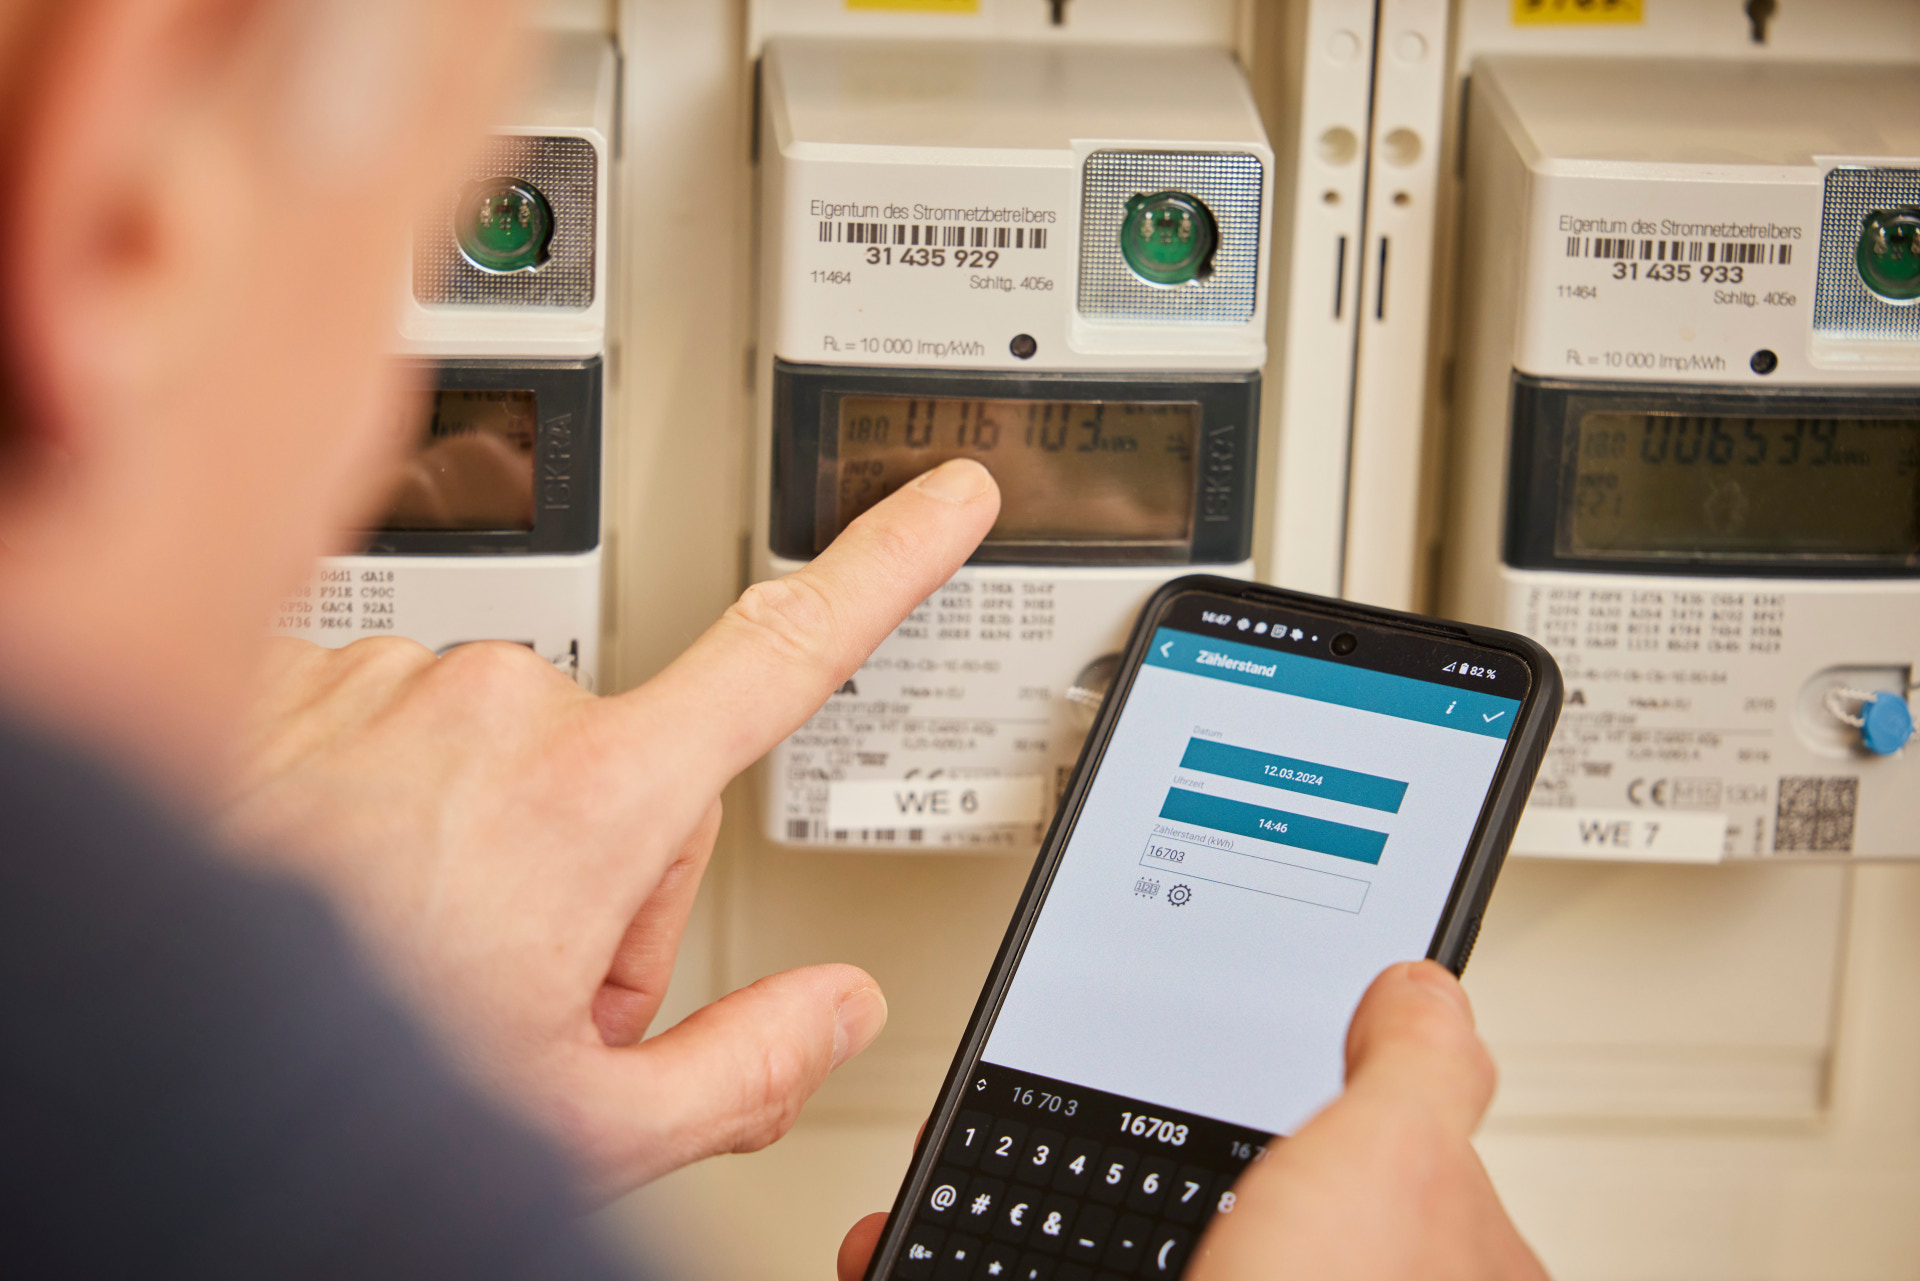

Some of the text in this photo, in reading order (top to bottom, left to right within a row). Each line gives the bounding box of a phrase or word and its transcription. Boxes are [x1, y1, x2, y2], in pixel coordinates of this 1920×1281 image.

[810, 200, 1057, 224] Eigentum des Stromnetzbetreibers
[1559, 215, 1802, 240] Eigentum des Stromnetzbetreibers
[866, 247, 999, 268] 31 435 929
[811, 270, 852, 285] 11464
[1020, 276, 1054, 291] 405e
[1612, 262, 1744, 284] 31 435 933
[1557, 285, 1598, 299] 11464
[860, 337, 880, 353] 10
[883, 338, 913, 354] 000
[1626, 353, 1655, 368] 000
[1196, 649, 1278, 678] Zählerstand
[1470, 666, 1496, 680] 82 %
[1193, 725, 1223, 738] Datum
[1173, 776, 1205, 789] Uhrzeit
[1264, 764, 1324, 786] 12.03.2024
[896, 789, 978, 814] WE 6
[1153, 823, 1234, 850] Zählerstand (kWh)
[1258, 818, 1288, 833] 14:46
[1579, 820, 1661, 847] WE 7
[1148, 845, 1186, 862] 16703
[1013, 1087, 1078, 1116] 16 70 3
[1120, 1112, 1189, 1146] 16703
[965, 1128, 1236, 1213] 1 2 3 4 5 6 7 8
[930, 1184, 957, 1211] @
[971, 1194, 991, 1215] #
[1010, 1203, 1029, 1226] €
[1042, 1211, 1062, 1236] &
